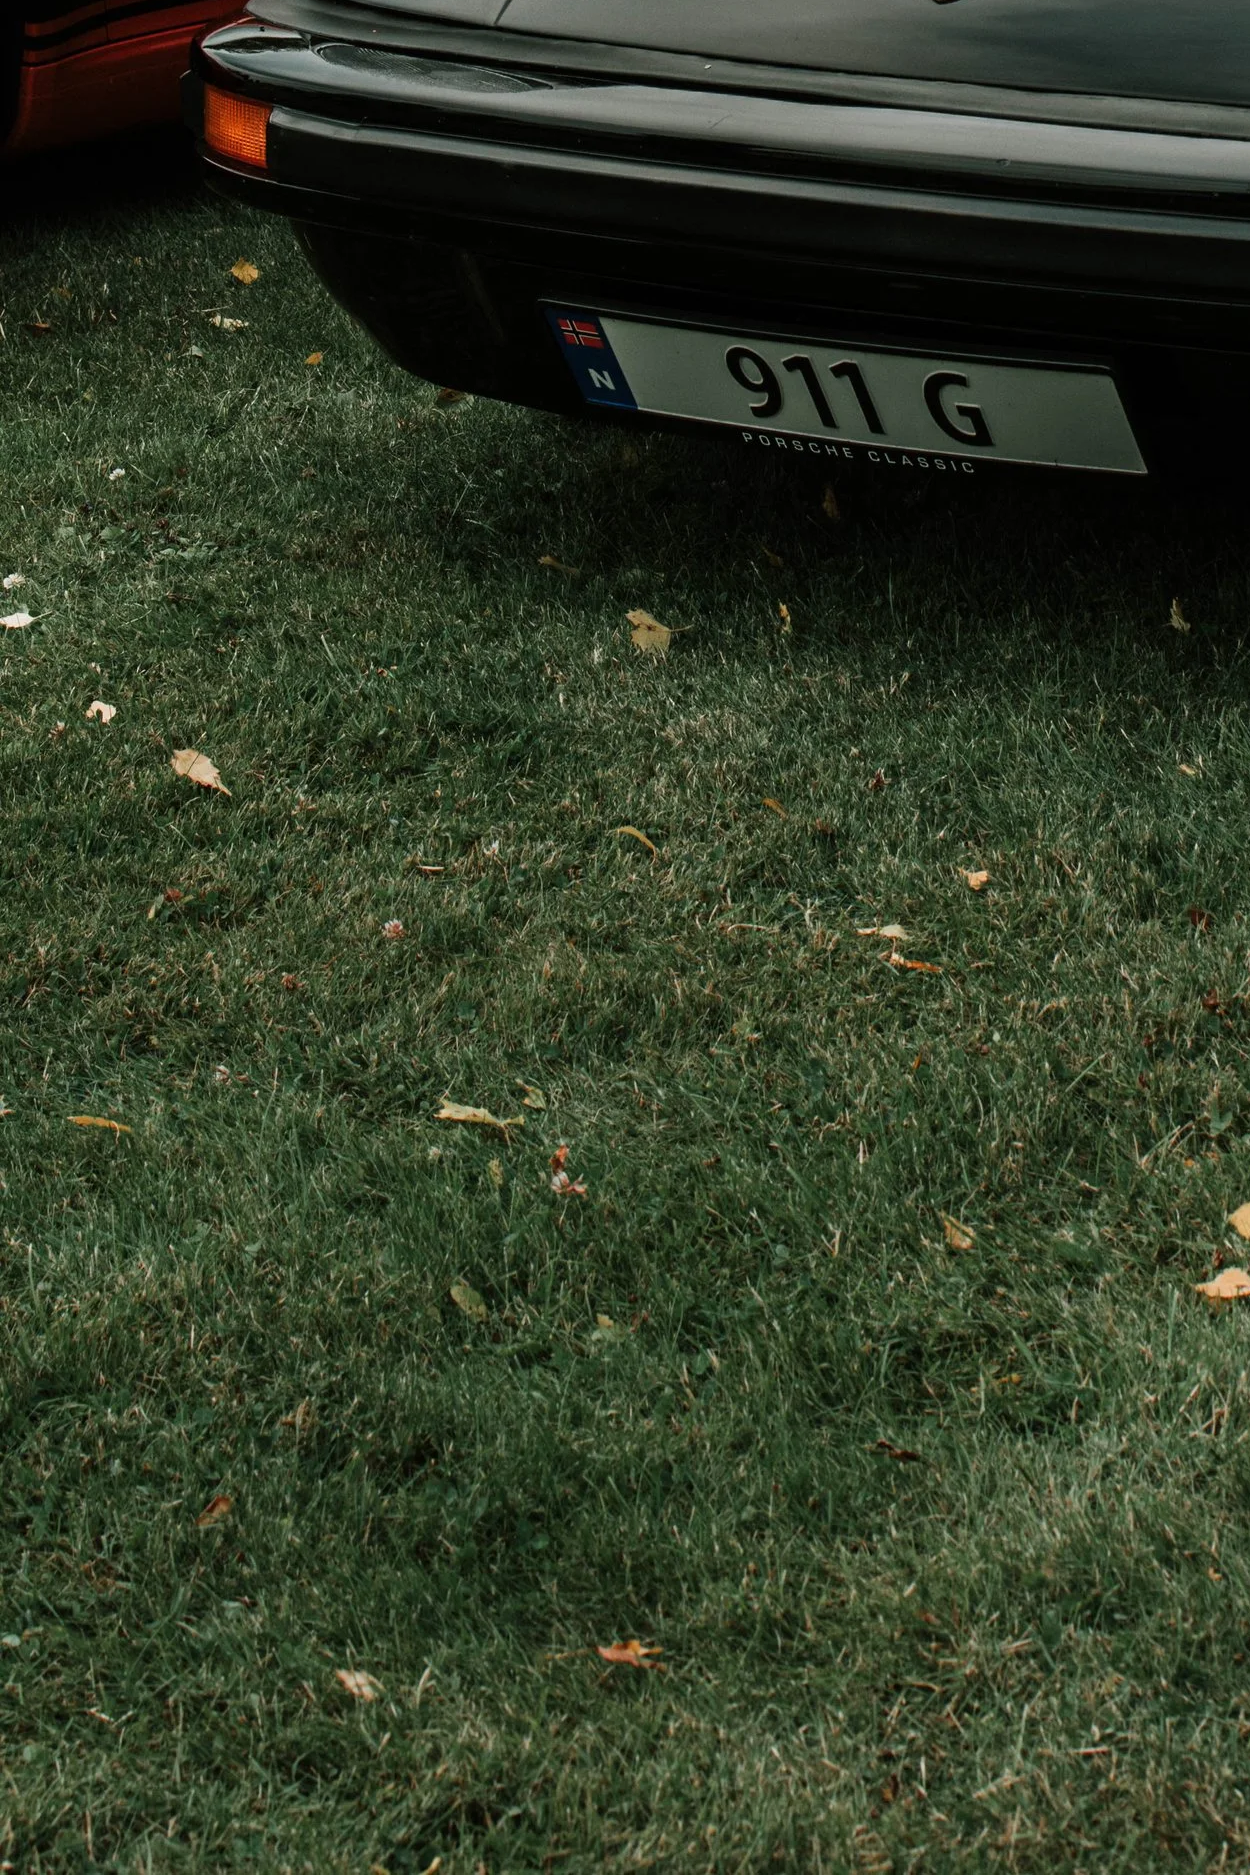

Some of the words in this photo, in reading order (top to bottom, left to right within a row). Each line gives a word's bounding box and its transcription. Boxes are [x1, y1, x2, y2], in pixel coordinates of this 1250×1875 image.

[587, 367, 616, 391] N
[725, 344, 887, 435] 911
[923, 370, 996, 447] G
[742, 431, 854, 459] PORSCHE
[867, 450, 976, 474] CLASSIC
